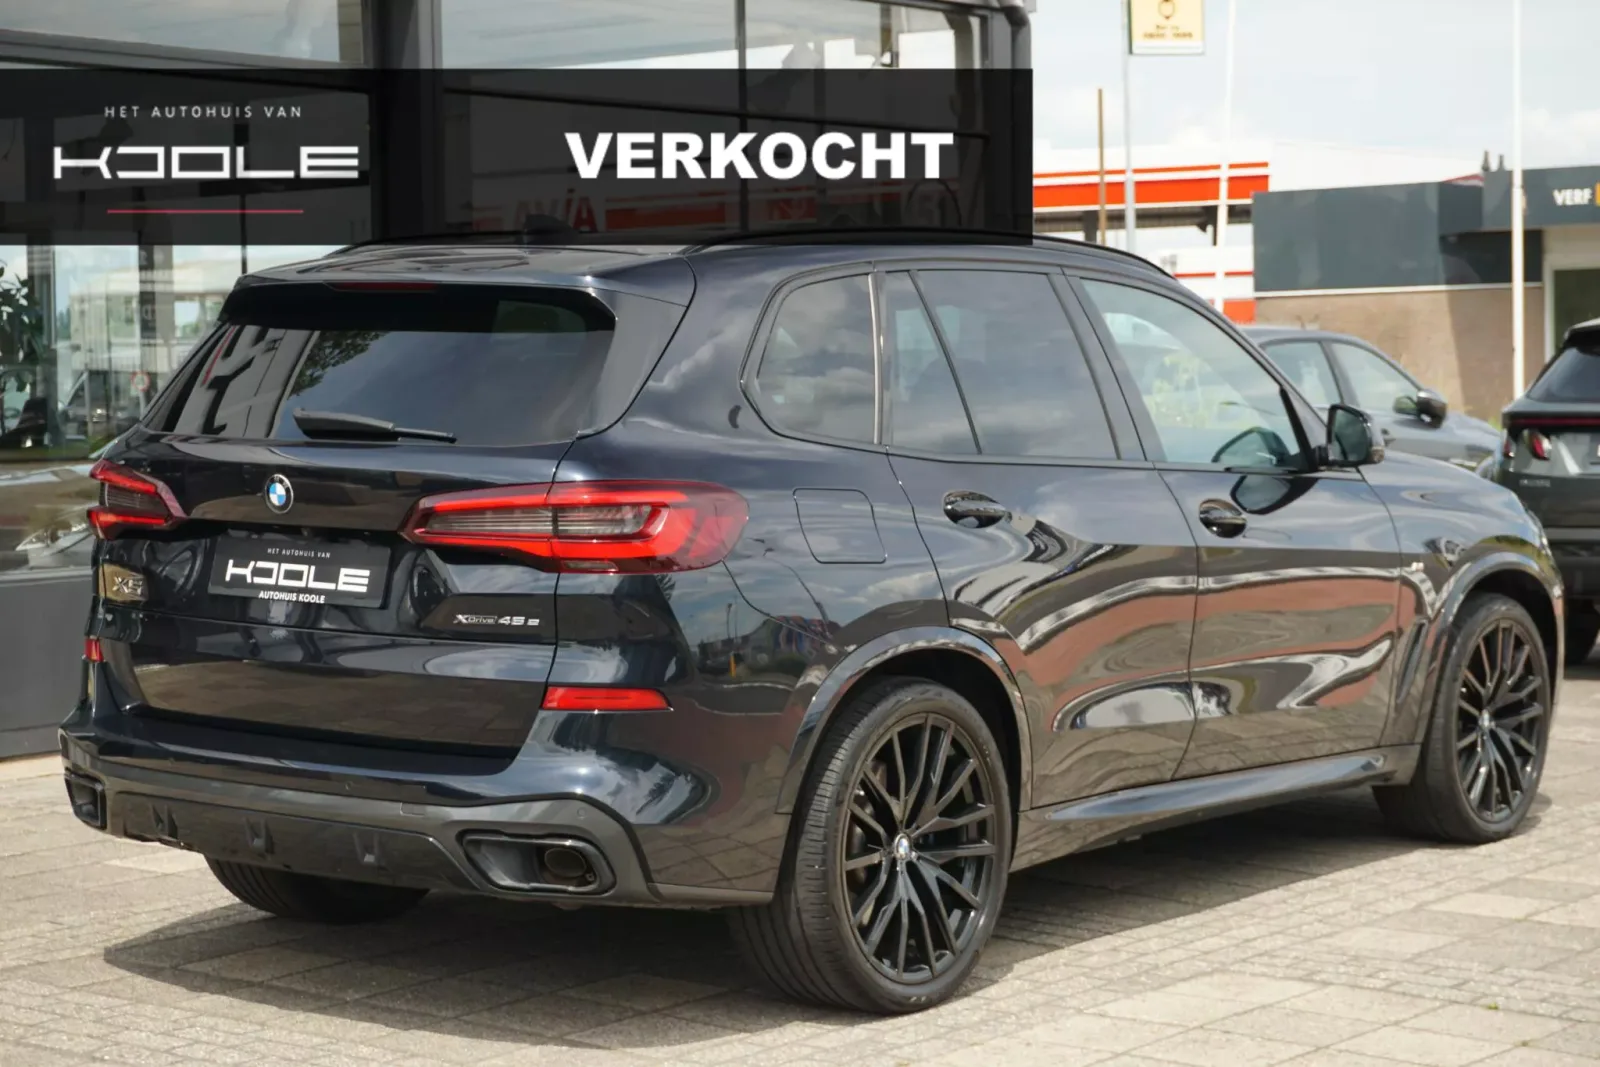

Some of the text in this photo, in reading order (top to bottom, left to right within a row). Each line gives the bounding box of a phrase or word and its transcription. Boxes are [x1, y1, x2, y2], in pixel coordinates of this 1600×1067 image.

[1553, 188, 1592, 205] VERF
[267, 547, 331, 559] HET AUTOHUIS VAN
[225, 559, 371, 593] KOOLE
[112, 576, 143, 595] X5
[258, 590, 326, 604] AUTOHUIS KOOLE
